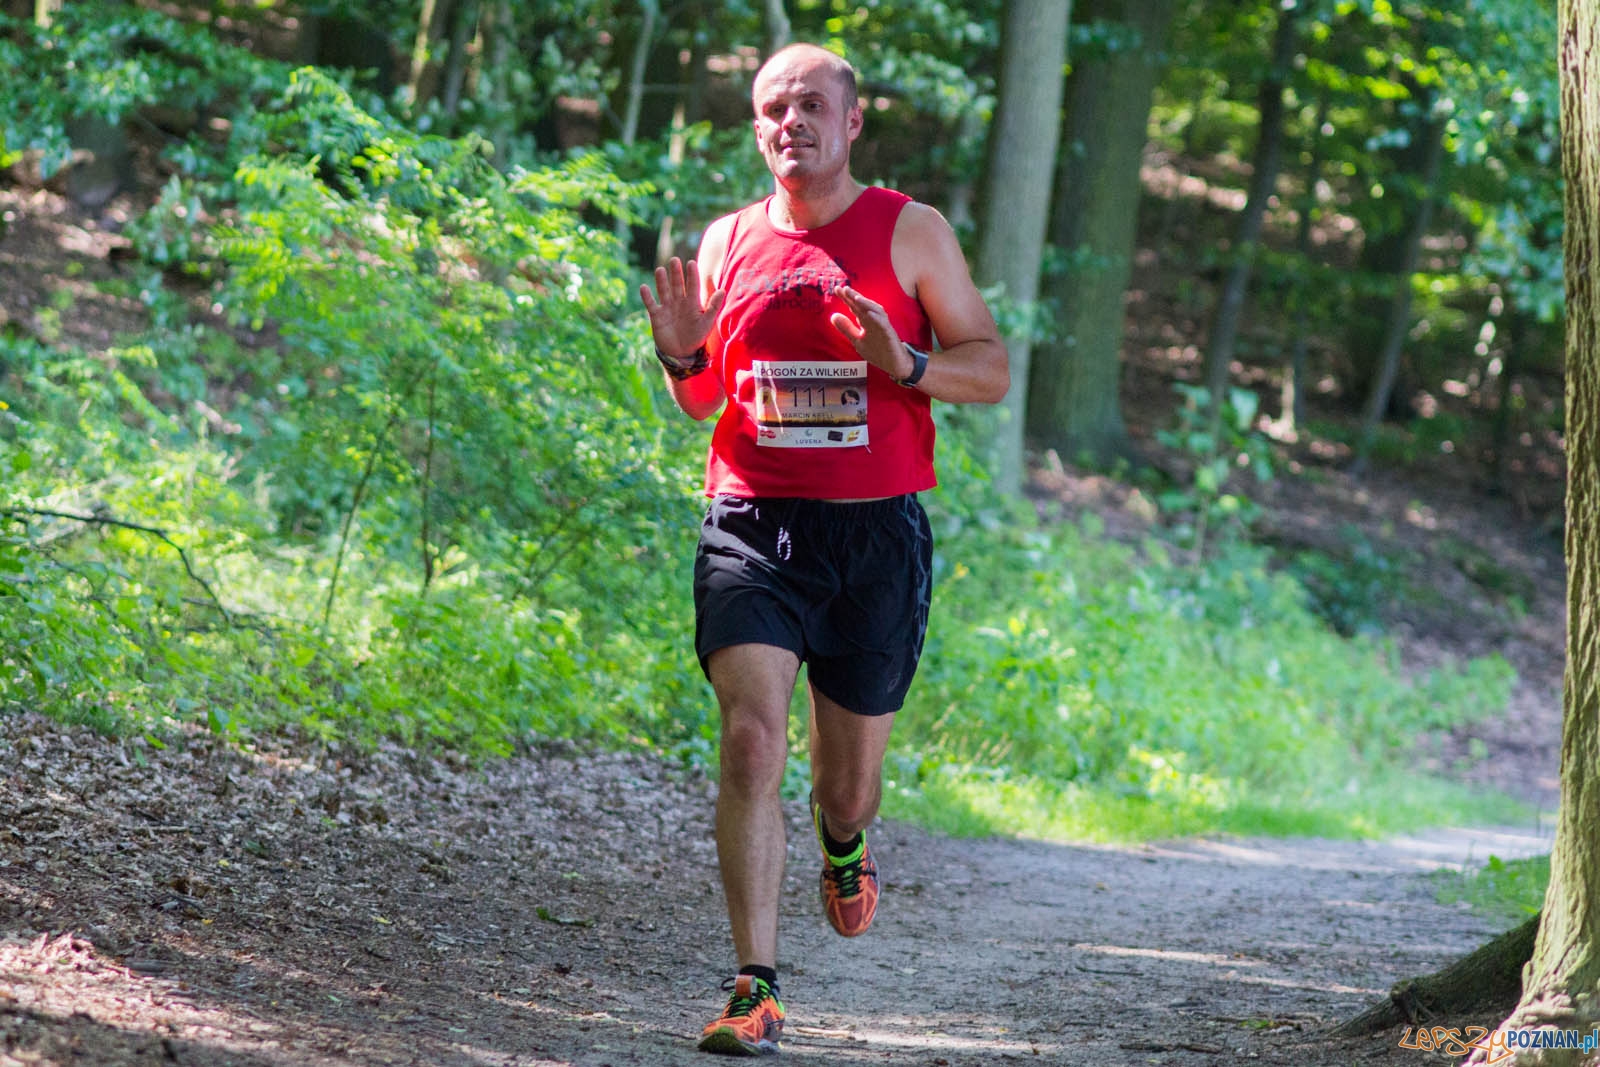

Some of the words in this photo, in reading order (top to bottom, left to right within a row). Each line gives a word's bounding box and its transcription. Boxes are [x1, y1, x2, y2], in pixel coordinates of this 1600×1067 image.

[760, 365, 797, 377] POGOŃ
[799, 367, 813, 377] ZA
[815, 367, 858, 377] WILKIEM
[789, 386, 826, 408] 111
